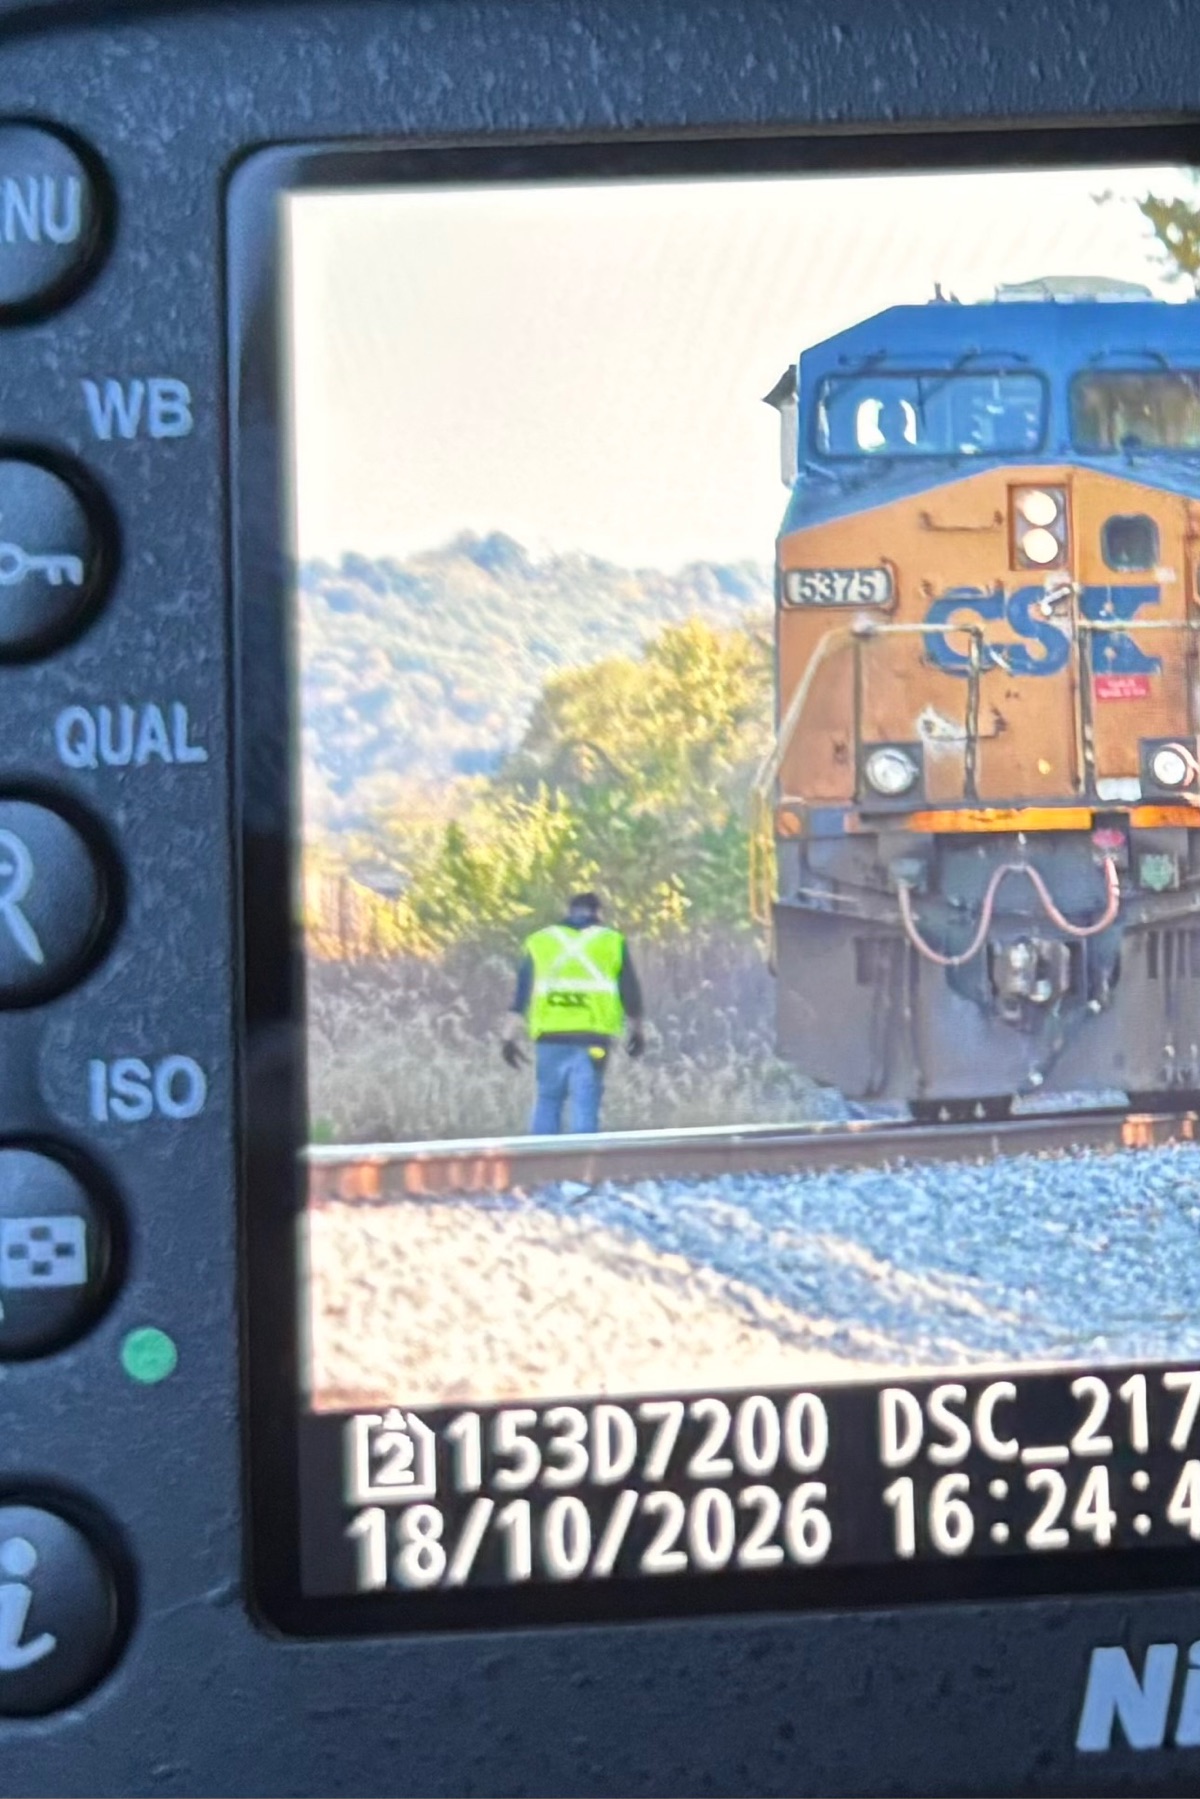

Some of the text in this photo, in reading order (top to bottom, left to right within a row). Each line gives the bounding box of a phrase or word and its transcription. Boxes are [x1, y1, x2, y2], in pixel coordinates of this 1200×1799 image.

[80, 376, 194, 440] WB
[798, 568, 876, 602] 5375
[922, 584, 1163, 679] CSX
[54, 702, 208, 770] QUAL
[87, 1053, 208, 1123] ISO
[444, 1392, 829, 1493] 153D7200
[347, 1481, 833, 1592] 18/10/2026
